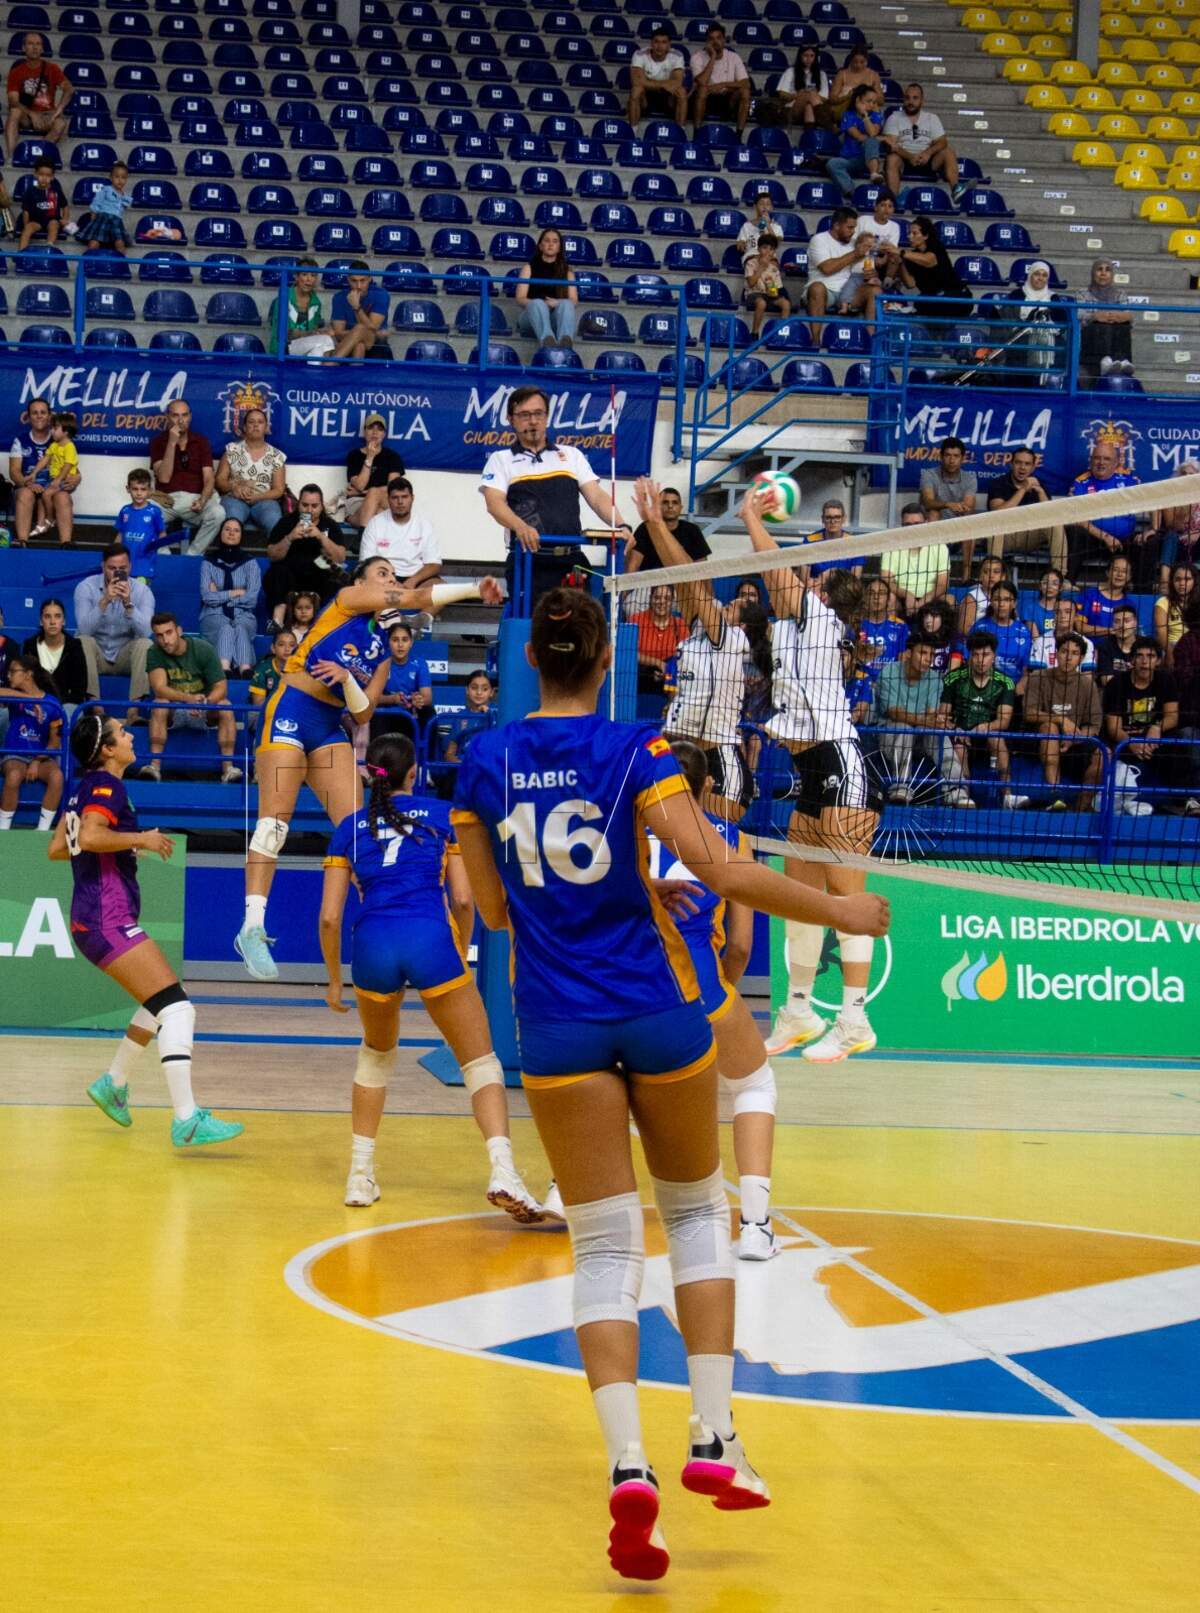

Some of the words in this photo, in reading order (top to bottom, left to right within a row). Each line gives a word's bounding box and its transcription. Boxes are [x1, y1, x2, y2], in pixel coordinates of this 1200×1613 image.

[20, 365, 189, 410] MELILLA
[286, 389, 341, 404] CIUDAD
[344, 390, 432, 408] AUTÓNOMA
[82, 412, 108, 428] DEL
[115, 413, 169, 431] DEPORT
[463, 384, 627, 432] MILLA
[289, 406, 432, 441] MELILA
[463, 430, 517, 445] CIUDAD
[894, 403, 1052, 449] MELILLA
[1148, 427, 1200, 440] CIUDAD
[106, 434, 150, 445] DEPORTIVAS
[440, 663, 446, 672] 3
[511, 769, 579, 790] BABIC
[377, 824, 415, 868] 7
[497, 798, 612, 888] 16
[940, 914, 1004, 940] LIGA
[1010, 915, 1171, 944] IBERDROLA
[1016, 963, 1185, 1004] Iberdrola
